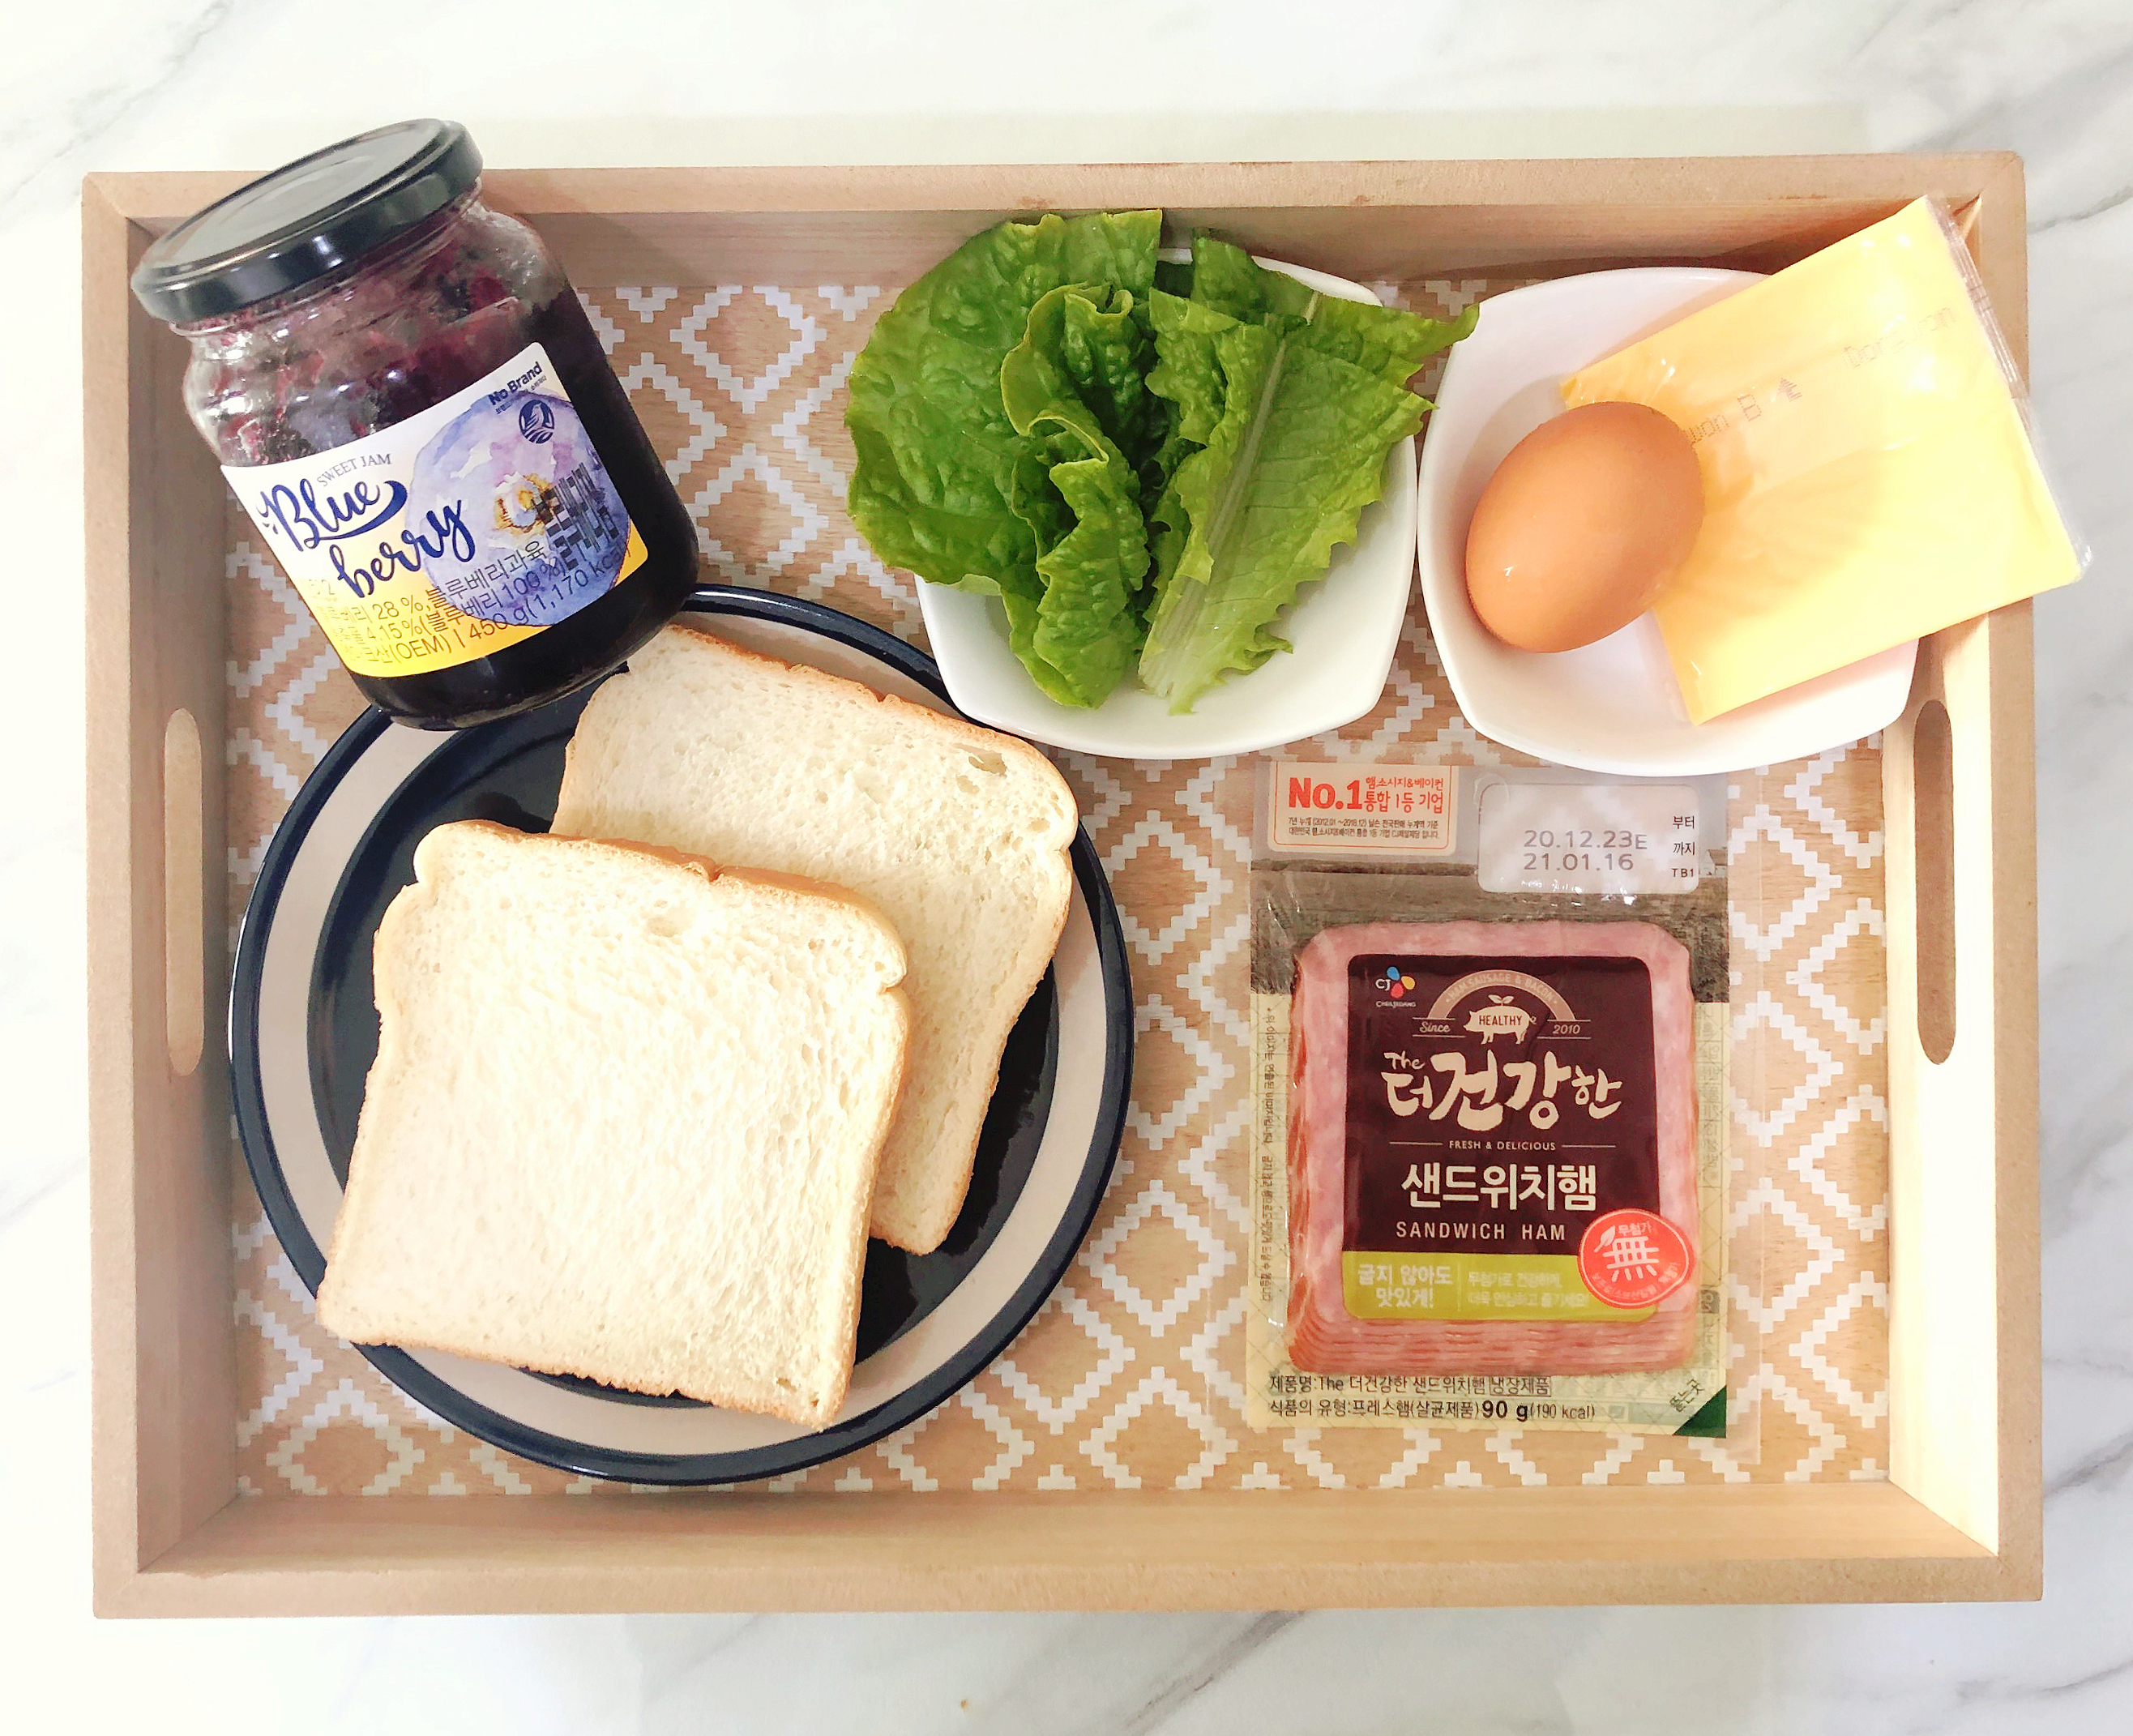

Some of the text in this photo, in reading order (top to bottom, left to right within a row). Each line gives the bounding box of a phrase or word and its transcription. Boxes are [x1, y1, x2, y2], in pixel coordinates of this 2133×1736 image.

[488, 388, 508, 405] No
[507, 361, 542, 393] Brand
[316, 453, 391, 487] SWEET JAM
[256, 478, 408, 552] Blue
[329, 499, 476, 598] berry
[469, 613, 508, 639] 450
[1289, 777, 1362, 810] No.1
[1364, 790, 1443, 814] 통합 1등 기업
[1427, 820, 1438, 829] 기준
[1672, 815, 1695, 830] 부터
[1673, 841, 1695, 856] 까지
[1523, 853, 1634, 871] 21.01.16
[1375, 978, 1391, 991] CJ
[1419, 1021, 1451, 1033] Since
[1479, 1015, 1523, 1026] HEALTHY
[1552, 1024, 1581, 1035] 2010
[1383, 1050, 1426, 1070] The
[1448, 1140, 1557, 1152] FRESH & DELICIOUS
[1401, 1162, 1597, 1212] 샌드위치햄
[1396, 1221, 1566, 1241] SANDWICH HAM
[1618, 1221, 1652, 1237] 무첨가
[1602, 1236, 1660, 1282] 無
[1400, 1264, 1453, 1286] 않아도
[1349, 1375, 1407, 1393] 더건강한
[1413, 1375, 1485, 1395] 샌드위치햄
[1491, 1376, 1550, 1396] 냉장제품
[1270, 1399, 1312, 1417] 식품의
[1561, 1403, 1596, 1421] kcal)
